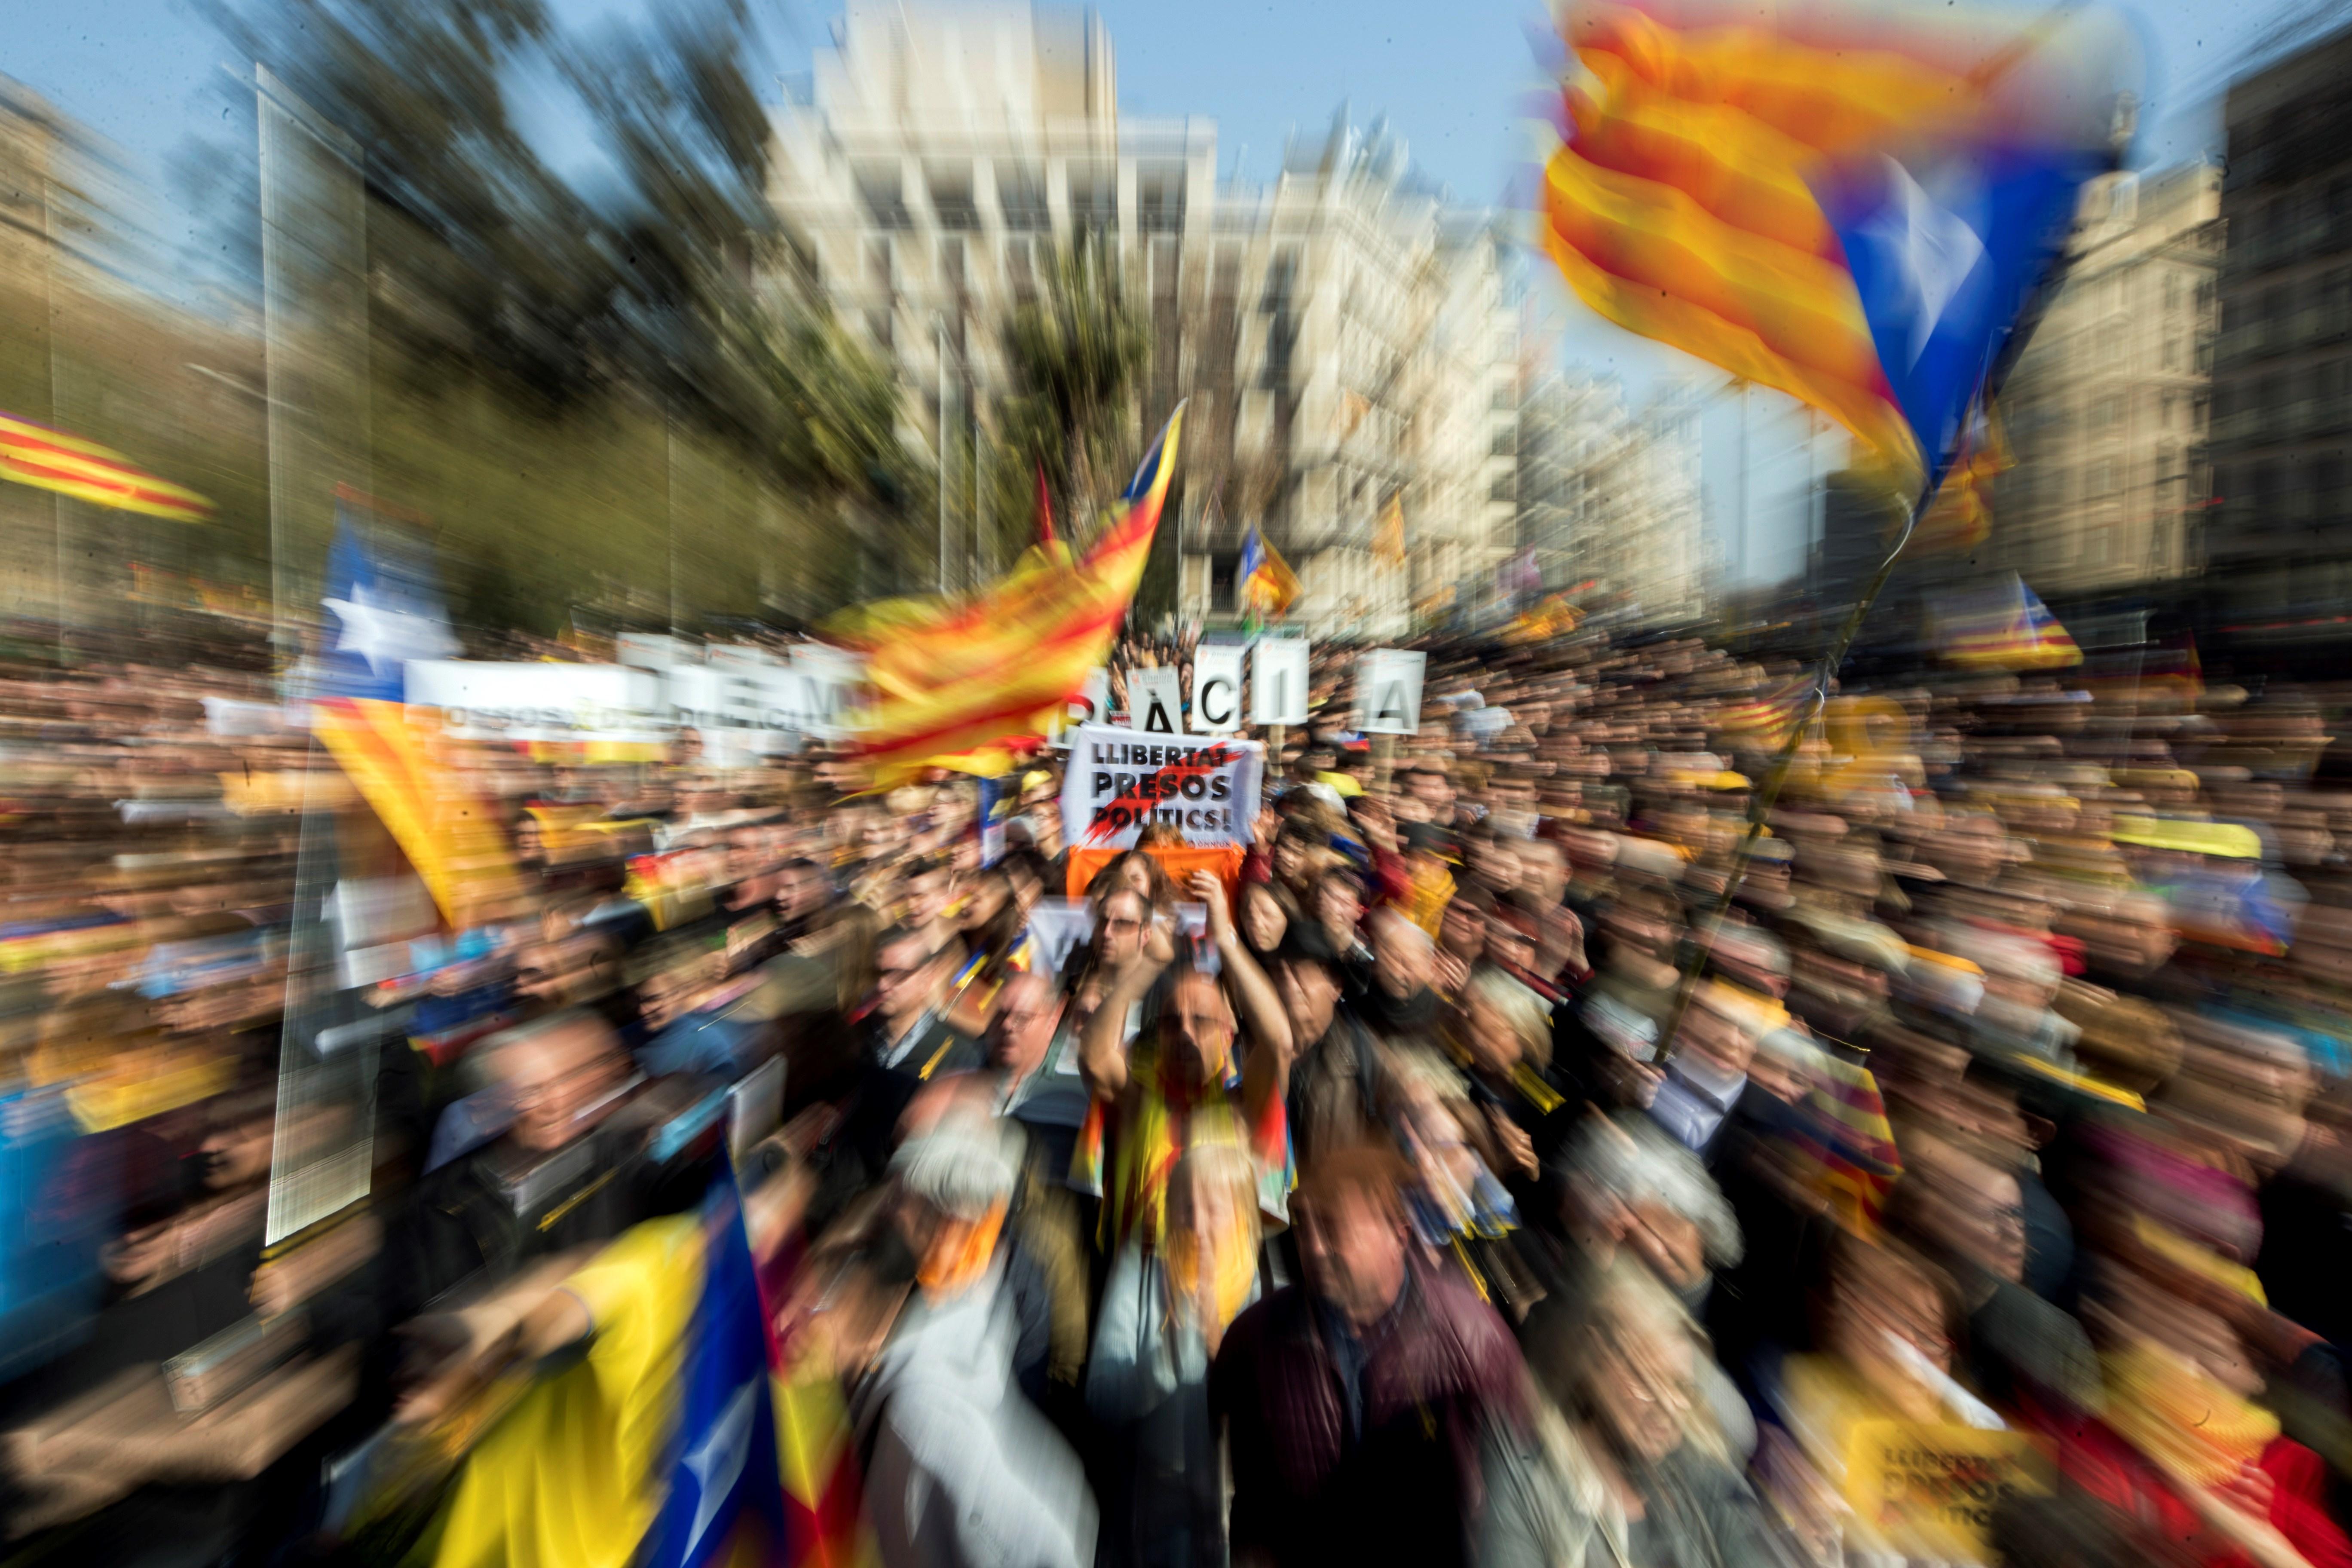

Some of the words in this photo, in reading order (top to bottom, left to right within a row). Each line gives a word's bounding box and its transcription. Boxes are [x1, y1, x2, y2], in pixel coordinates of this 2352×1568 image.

[1145, 688, 1174, 733] À
[1202, 678, 1236, 724] C
[1374, 679, 1413, 729] A
[1090, 743, 1229, 767] LLIBERTAT
[1090, 772, 1232, 802] PRESOS
[1090, 802, 1232, 833] POLÍTICS!
